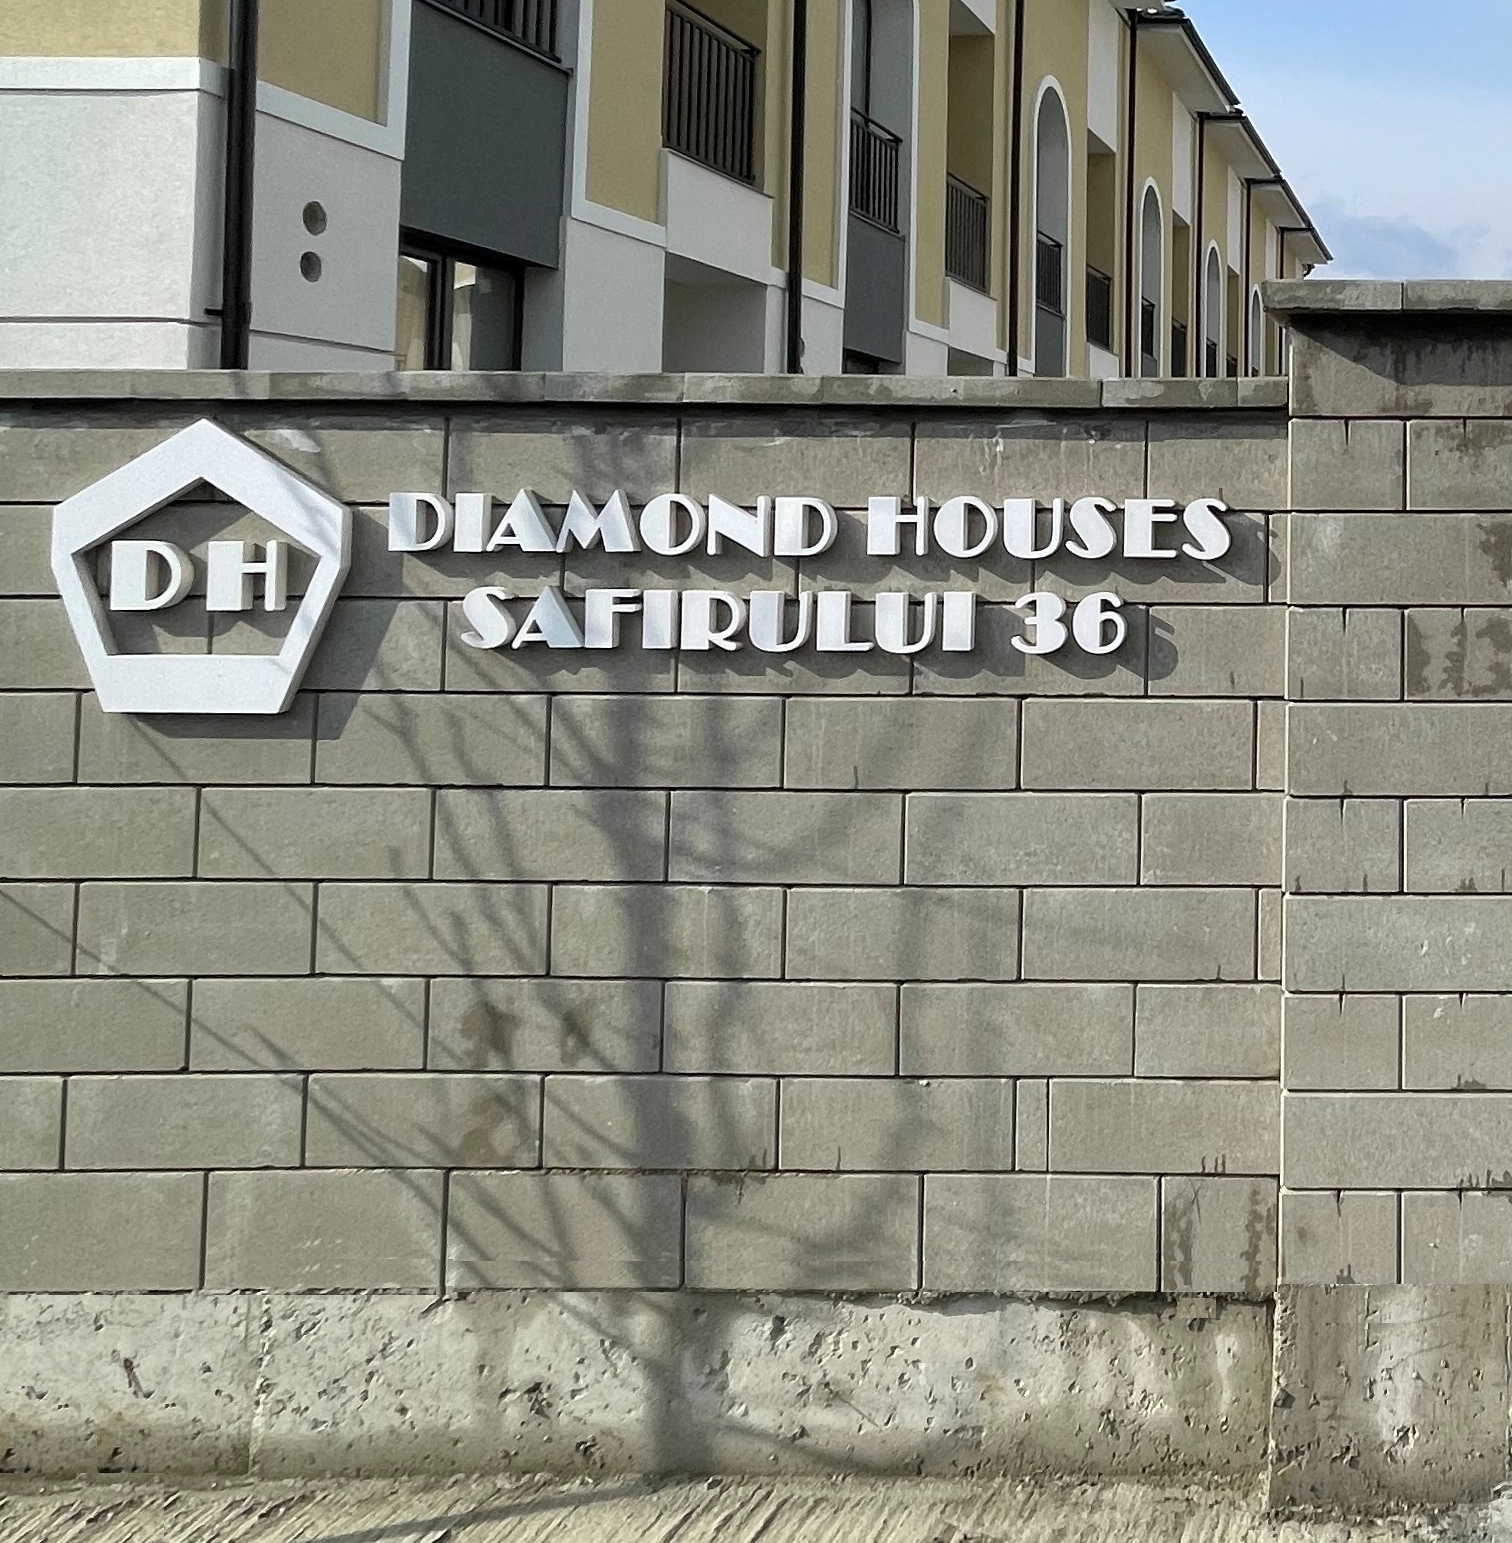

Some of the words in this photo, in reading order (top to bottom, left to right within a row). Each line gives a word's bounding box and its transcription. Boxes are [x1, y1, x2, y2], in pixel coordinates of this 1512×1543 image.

[386, 488, 838, 557] DIAMOND
[867, 495, 1231, 560] HOUSES
[460, 585, 976, 654] SAFIRULUI
[1011, 591, 1128, 655] 36
